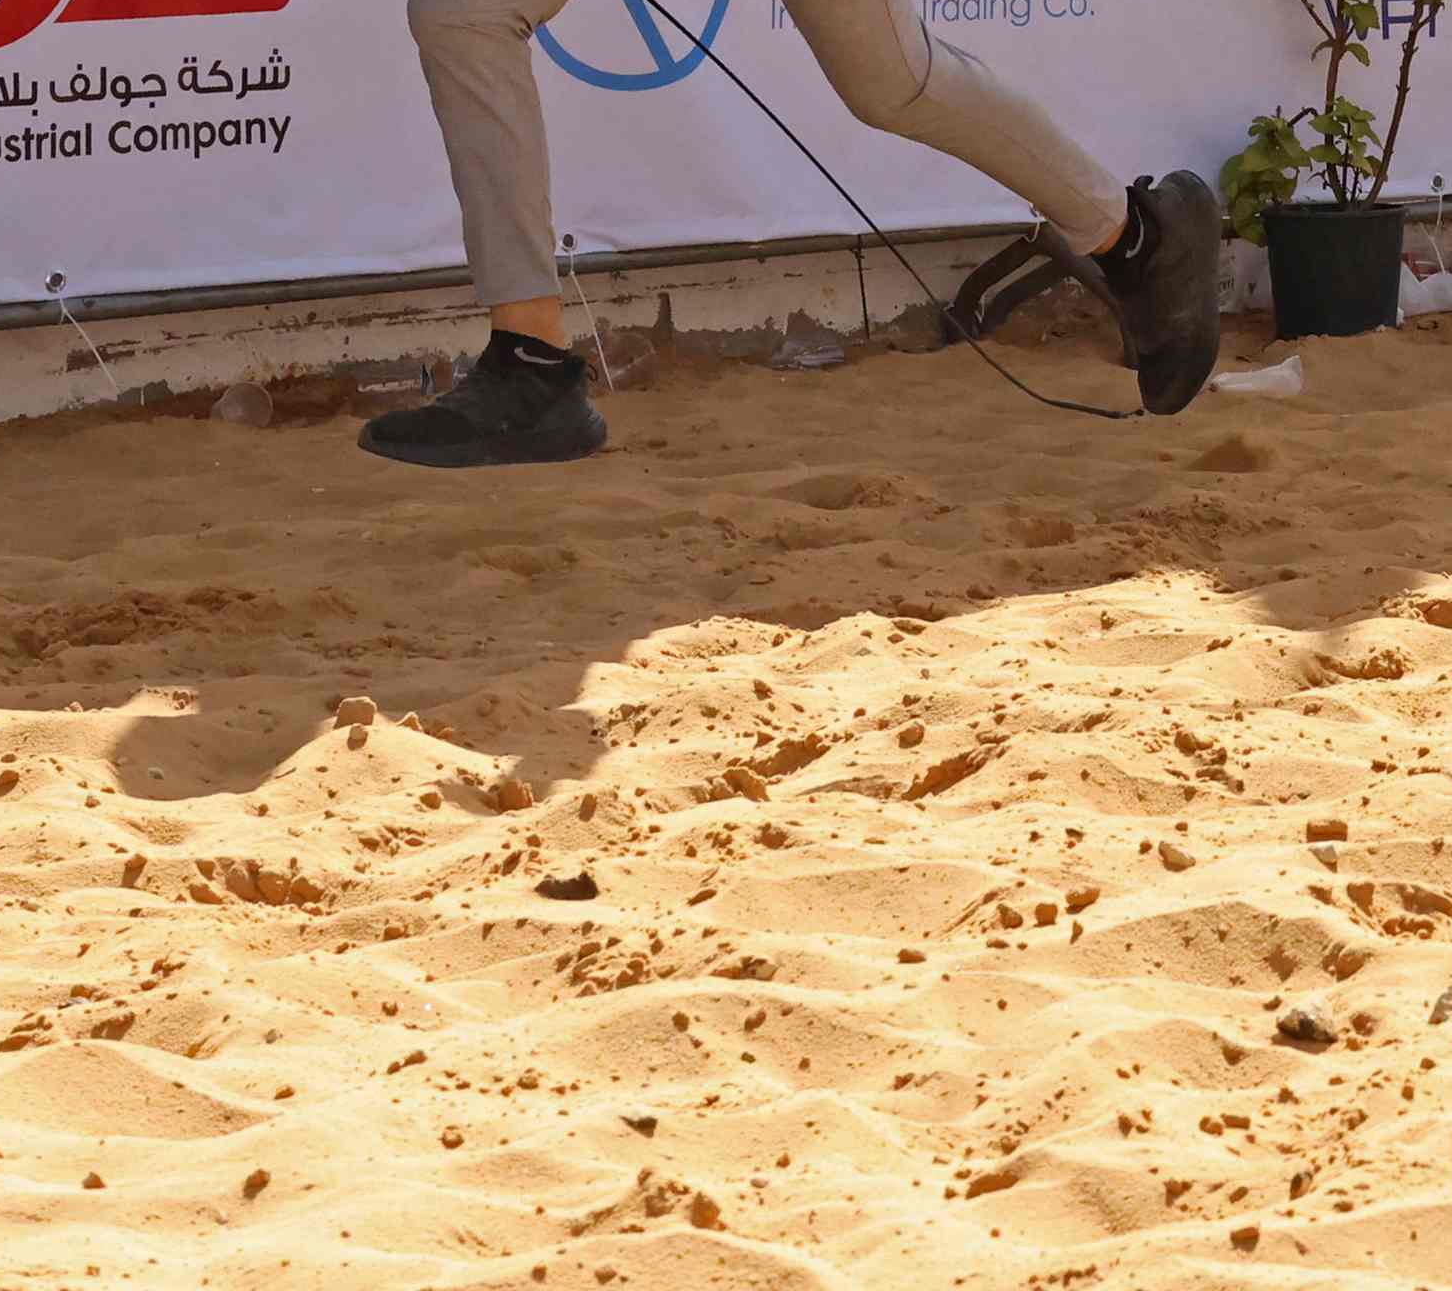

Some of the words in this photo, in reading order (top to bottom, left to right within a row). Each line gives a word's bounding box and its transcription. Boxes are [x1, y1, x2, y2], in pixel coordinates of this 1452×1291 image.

[49, 63, 167, 109] جولف
[178, 48, 292, 100] شركة
[107, 115, 292, 161] Company
